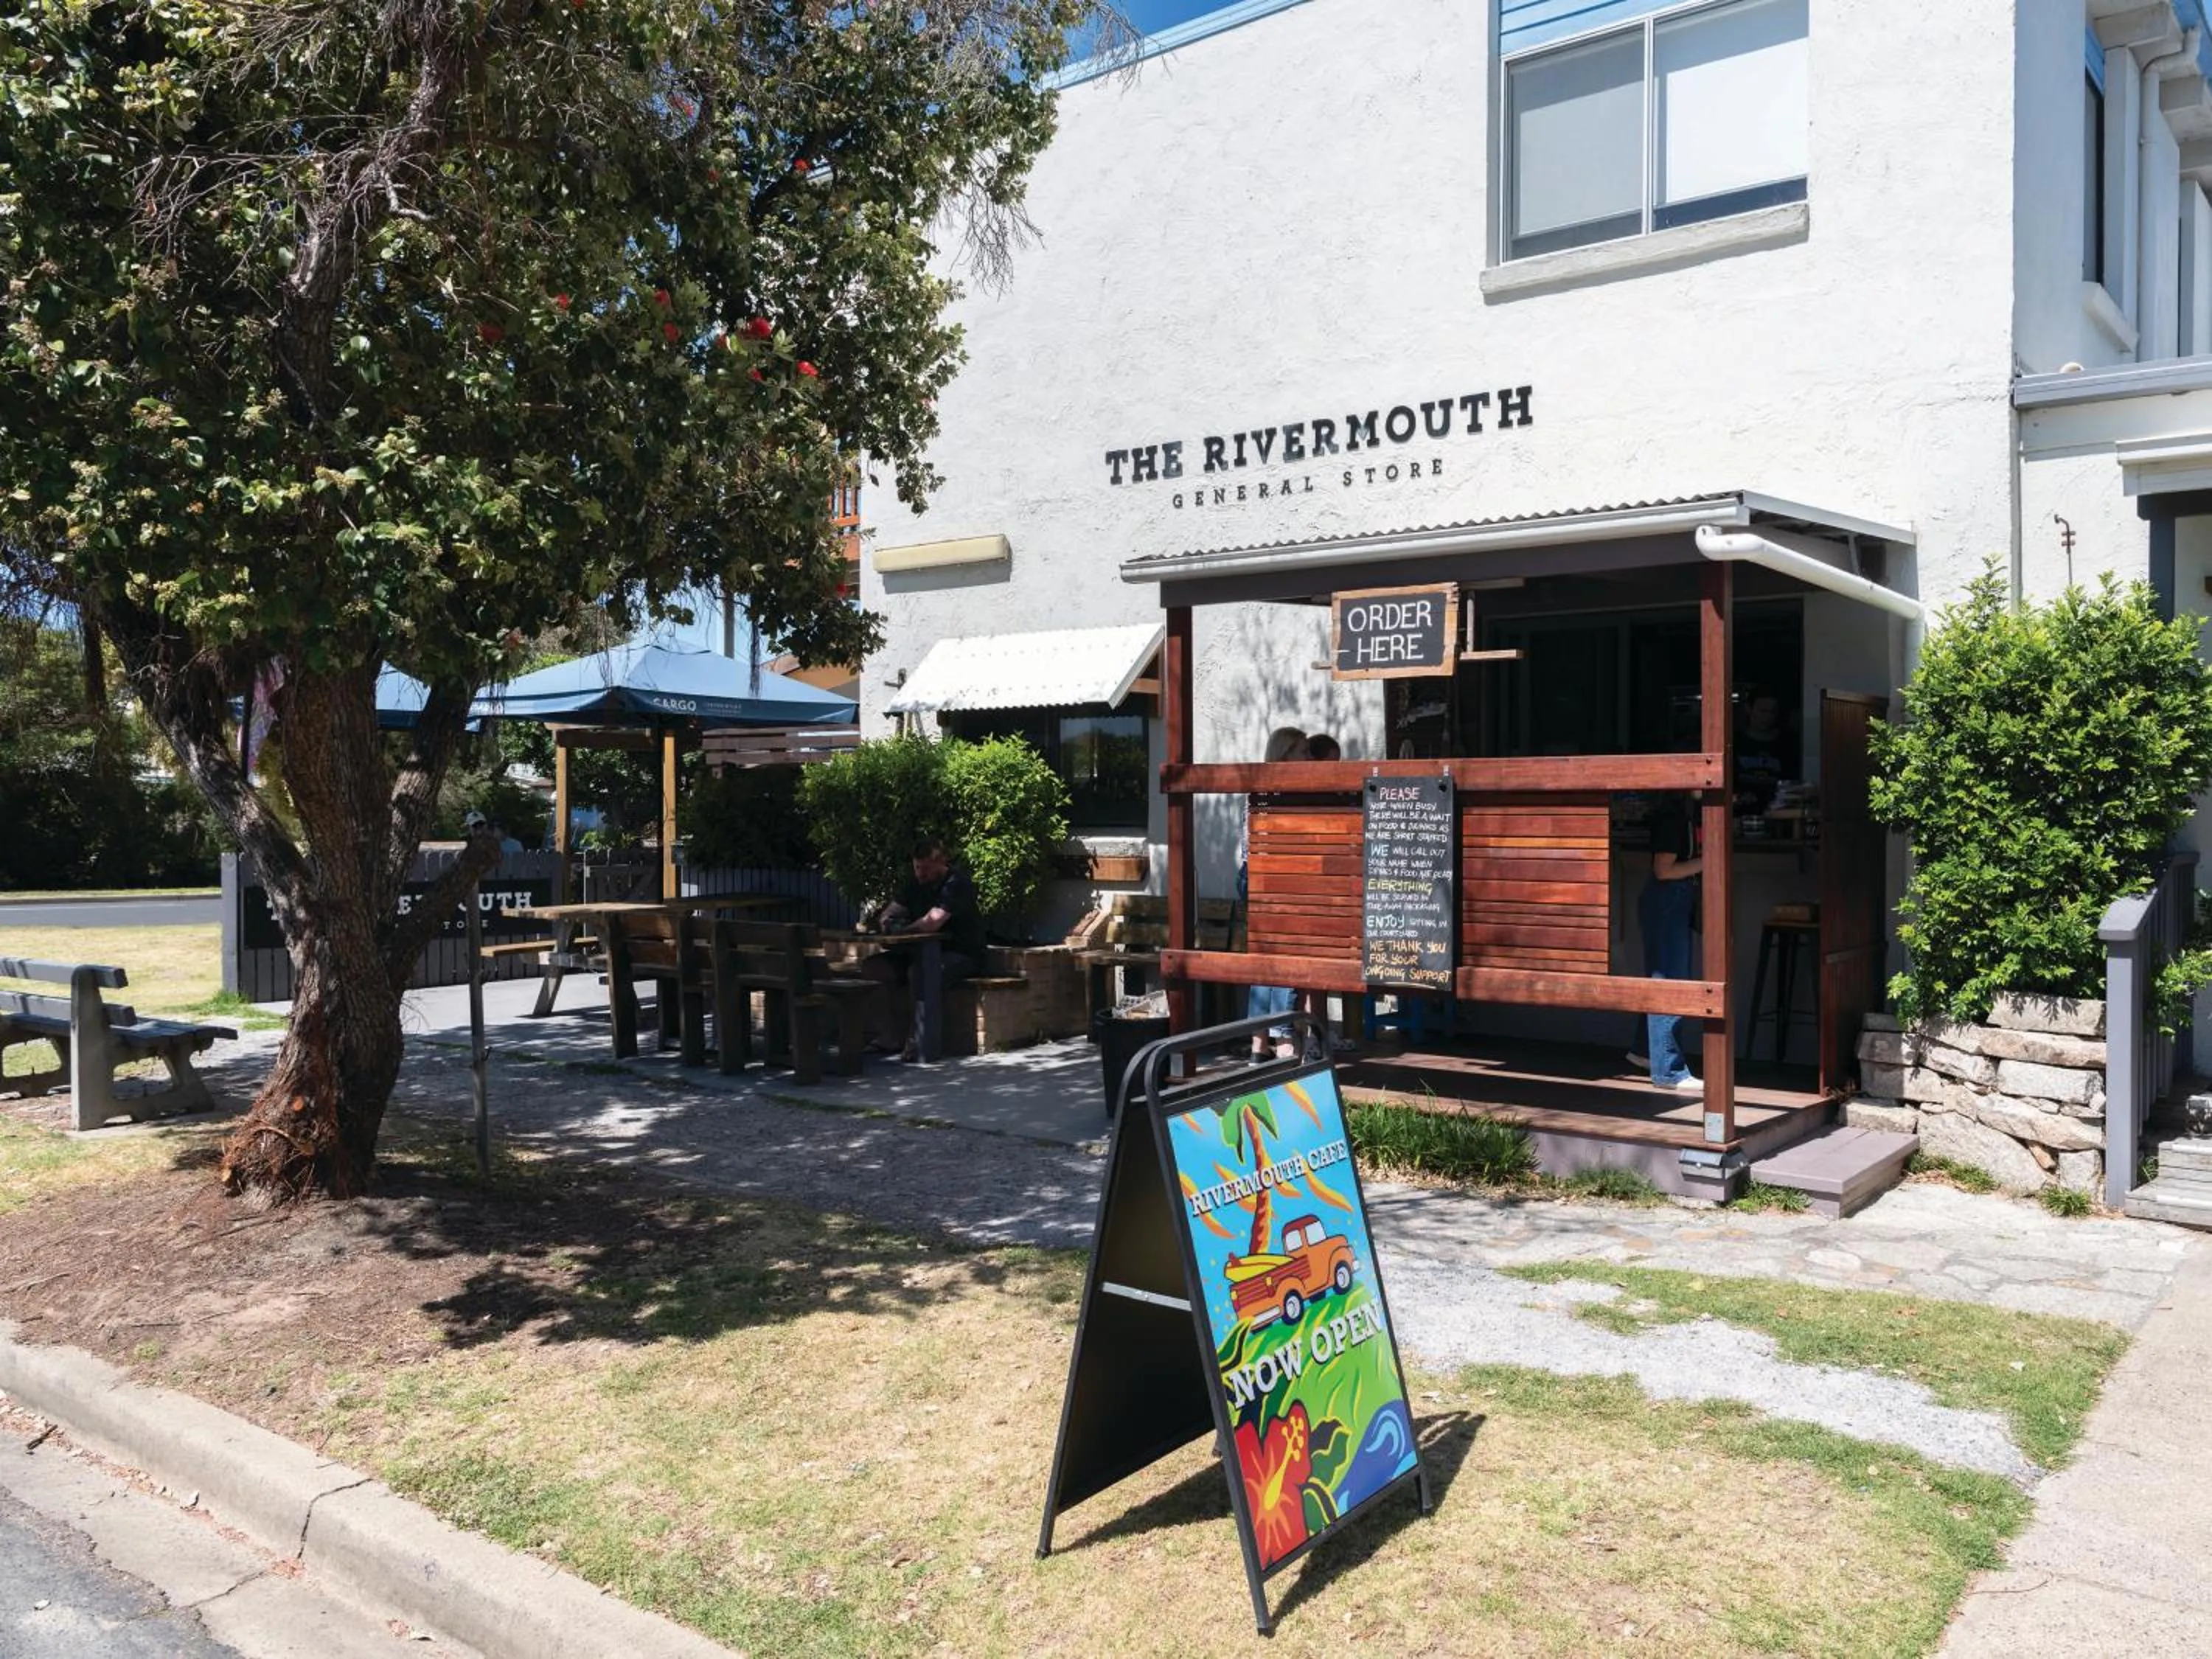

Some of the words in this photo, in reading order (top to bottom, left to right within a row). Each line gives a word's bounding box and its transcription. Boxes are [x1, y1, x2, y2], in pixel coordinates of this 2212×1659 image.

[1106, 440, 1183, 485] THE
[1203, 385, 1534, 473] RIVERMOUTH
[1172, 478, 1313, 509] GENERAL
[1343, 459, 1443, 487] STORE
[1347, 599, 1433, 632] ORDER
[1357, 633, 1425, 664] HERE
[653, 697, 697, 712] CARGO
[1380, 787, 1421, 801] PLEASE
[1415, 801, 1437, 811] BUSY
[1368, 811, 1391, 820] THERE
[1392, 811, 1407, 819] WILL
[1422, 812, 1428, 821] A
[1430, 813, 1451, 822] WAIT
[1379, 822, 1399, 830] FOOD
[1408, 823, 1437, 831] DRINKS
[1439, 824, 1450, 833] AS
[1365, 831, 1375, 840] WE
[1377, 831, 1391, 840] ARE
[1394, 832, 1416, 841] SHORT
[1371, 843, 1389, 856] WE
[1392, 846, 1409, 855] WILL
[1411, 846, 1427, 855] CALL
[1430, 849, 1446, 858] OUT
[1368, 858, 1387, 867] YOUR
[1388, 859, 1408, 867] NAME
[1411, 859, 1433, 868] WHEN
[1368, 878, 1433, 895] EVERYTHING
[1366, 914, 1405, 929] ENJOY
[1369, 940, 1384, 951] WE
[1385, 939, 1424, 953] THANK
[1427, 940, 1447, 953] YOU
[1369, 953, 1389, 964] FOR
[1391, 953, 1418, 966] YOUR
[1365, 964, 1405, 981] ONGOING
[1409, 967, 1452, 983] SUPPORT
[1189, 1155, 1306, 1217] RIVERMOUTH
[1308, 1139, 1349, 1171] CAFE
[1229, 1337, 1302, 1409] NOW
[1310, 1301, 1383, 1363] OPEN
